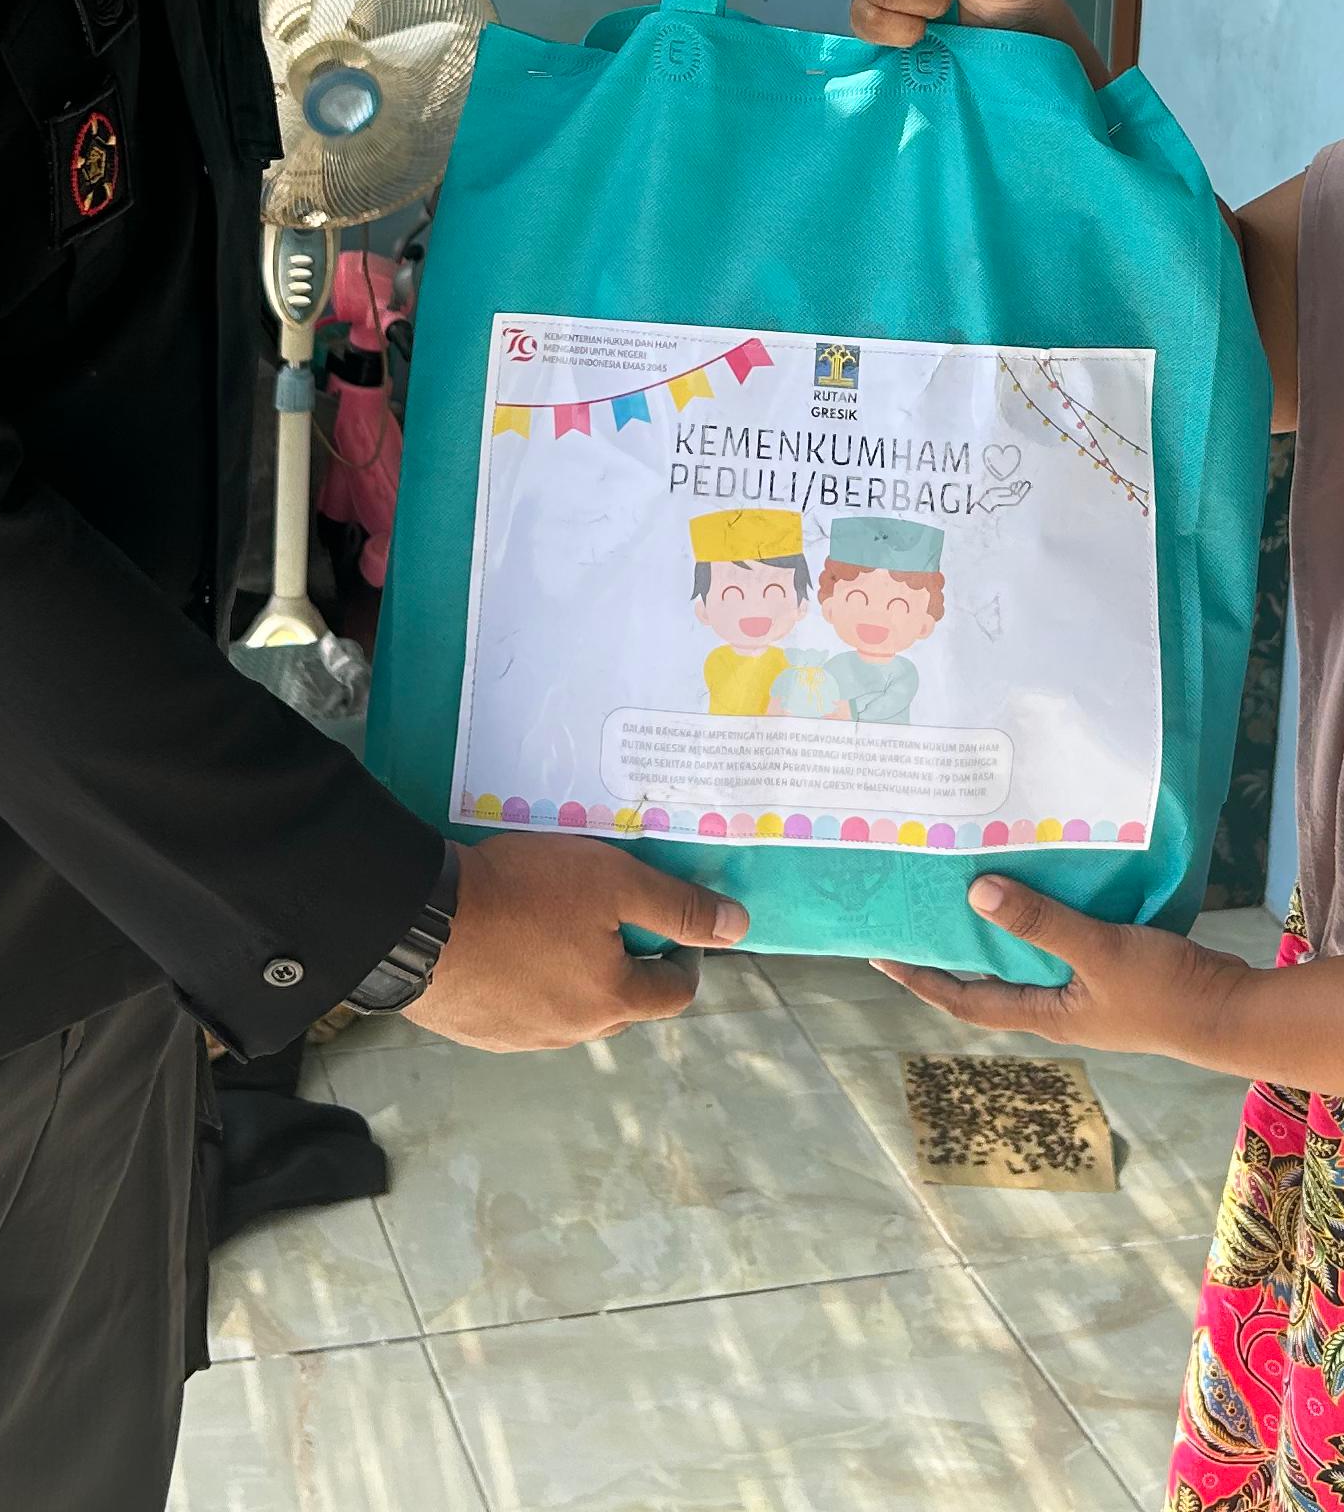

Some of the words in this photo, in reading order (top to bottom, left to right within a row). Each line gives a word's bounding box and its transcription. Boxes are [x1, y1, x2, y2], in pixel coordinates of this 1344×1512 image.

[544, 331, 605, 345] KEMENTERIAN
[606, 337, 634, 348] HUKUM
[635, 338, 654, 349] DAN
[656, 340, 677, 350] HAM
[543, 343, 589, 355] MENGABDI
[590, 346, 616, 357] UNTUK
[617, 349, 647, 360] NEGERI
[542, 354, 577, 366] MENUJU
[578, 357, 622, 370] INDONESIA
[623, 360, 646, 371] EMAS
[647, 362, 667, 373] 2045
[813, 390, 857, 404] RUTAN
[811, 406, 857, 421] GRESIK
[675, 422, 970, 475] KEMENKUMHAM
[669, 462, 973, 515] PEDULI/BERBAGI
[622, 739, 652, 751] RUTAN
[654, 742, 687, 754] GRESIK
[621, 755, 653, 768] WARGA
[655, 758, 692, 770] SEKITAR
[694, 760, 724, 771] DAPAT
[856, 767, 920, 780] PENGAYOMAN
[952, 773, 971, 783] DAN
[688, 776, 713, 787] YANG
[765, 777, 788, 787] OLEH
[933, 787, 957, 798] JAWA
